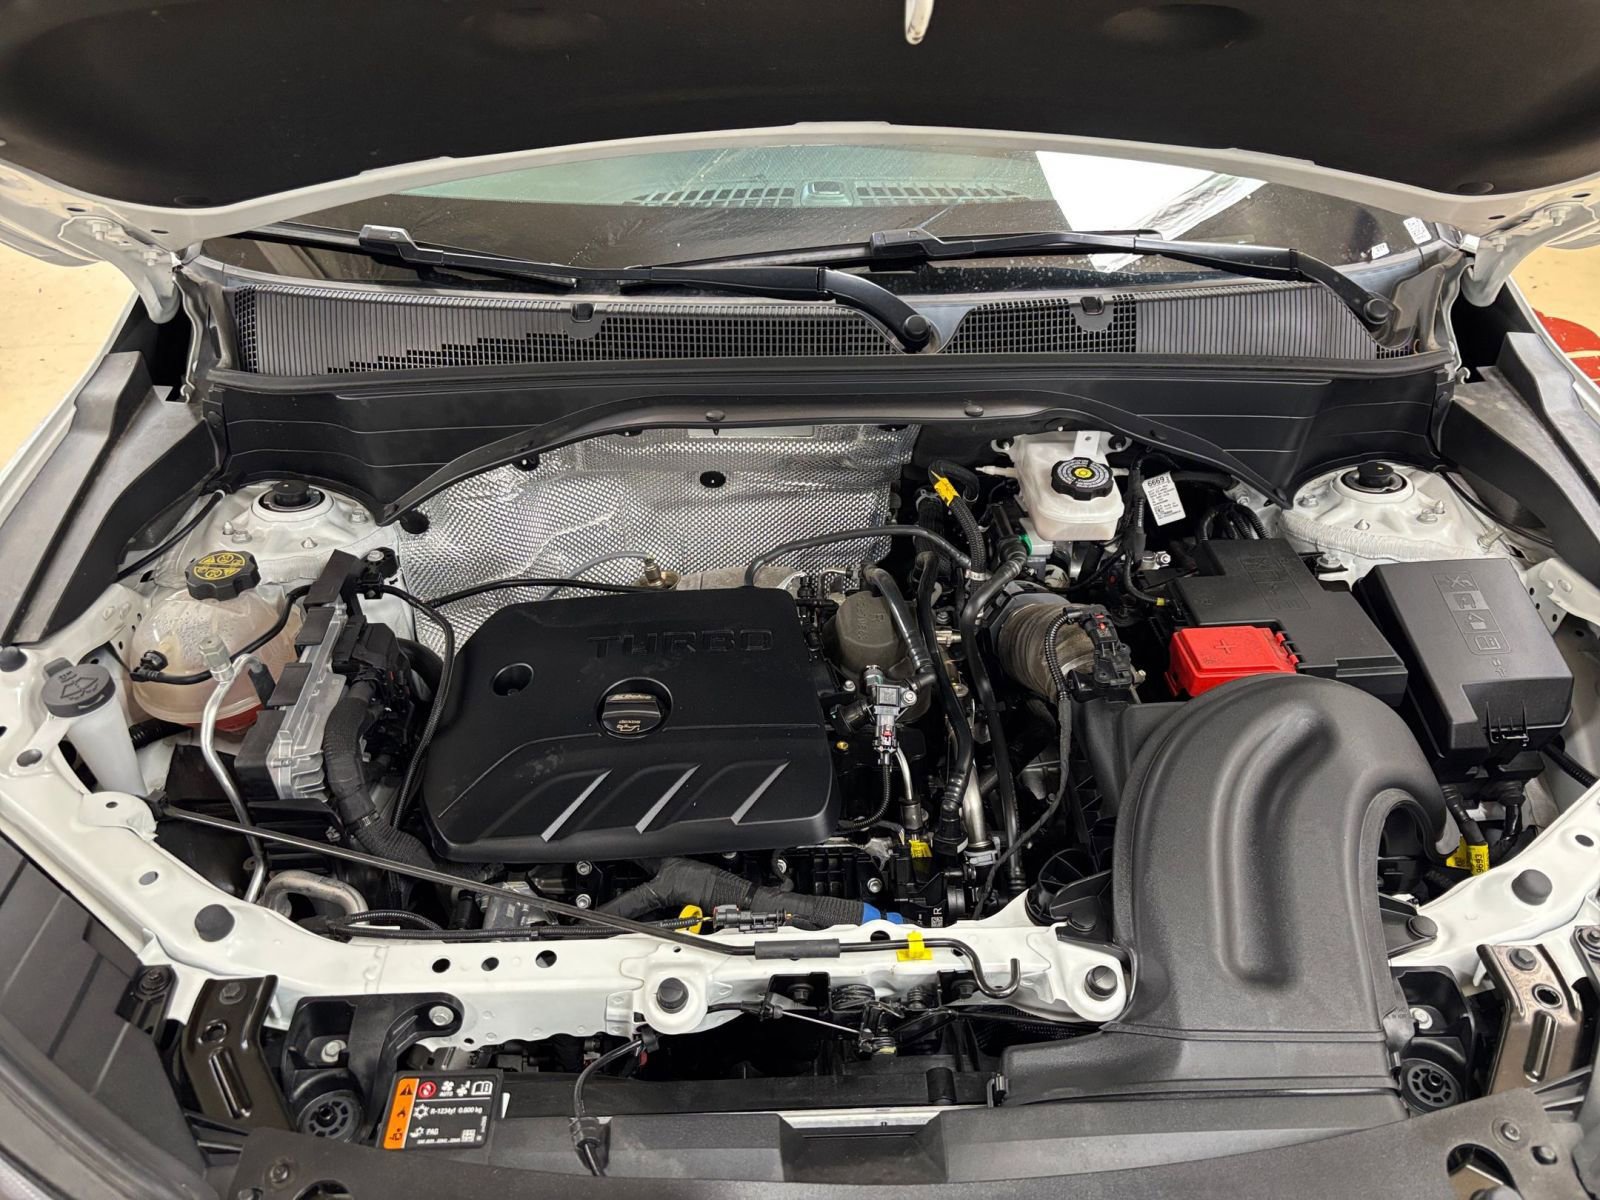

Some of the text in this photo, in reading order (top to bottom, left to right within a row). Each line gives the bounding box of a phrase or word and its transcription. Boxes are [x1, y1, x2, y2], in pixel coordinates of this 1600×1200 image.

[1147, 476, 1165, 487] 6669
[587, 629, 772, 658] TURBO
[933, 907, 942, 915] R
